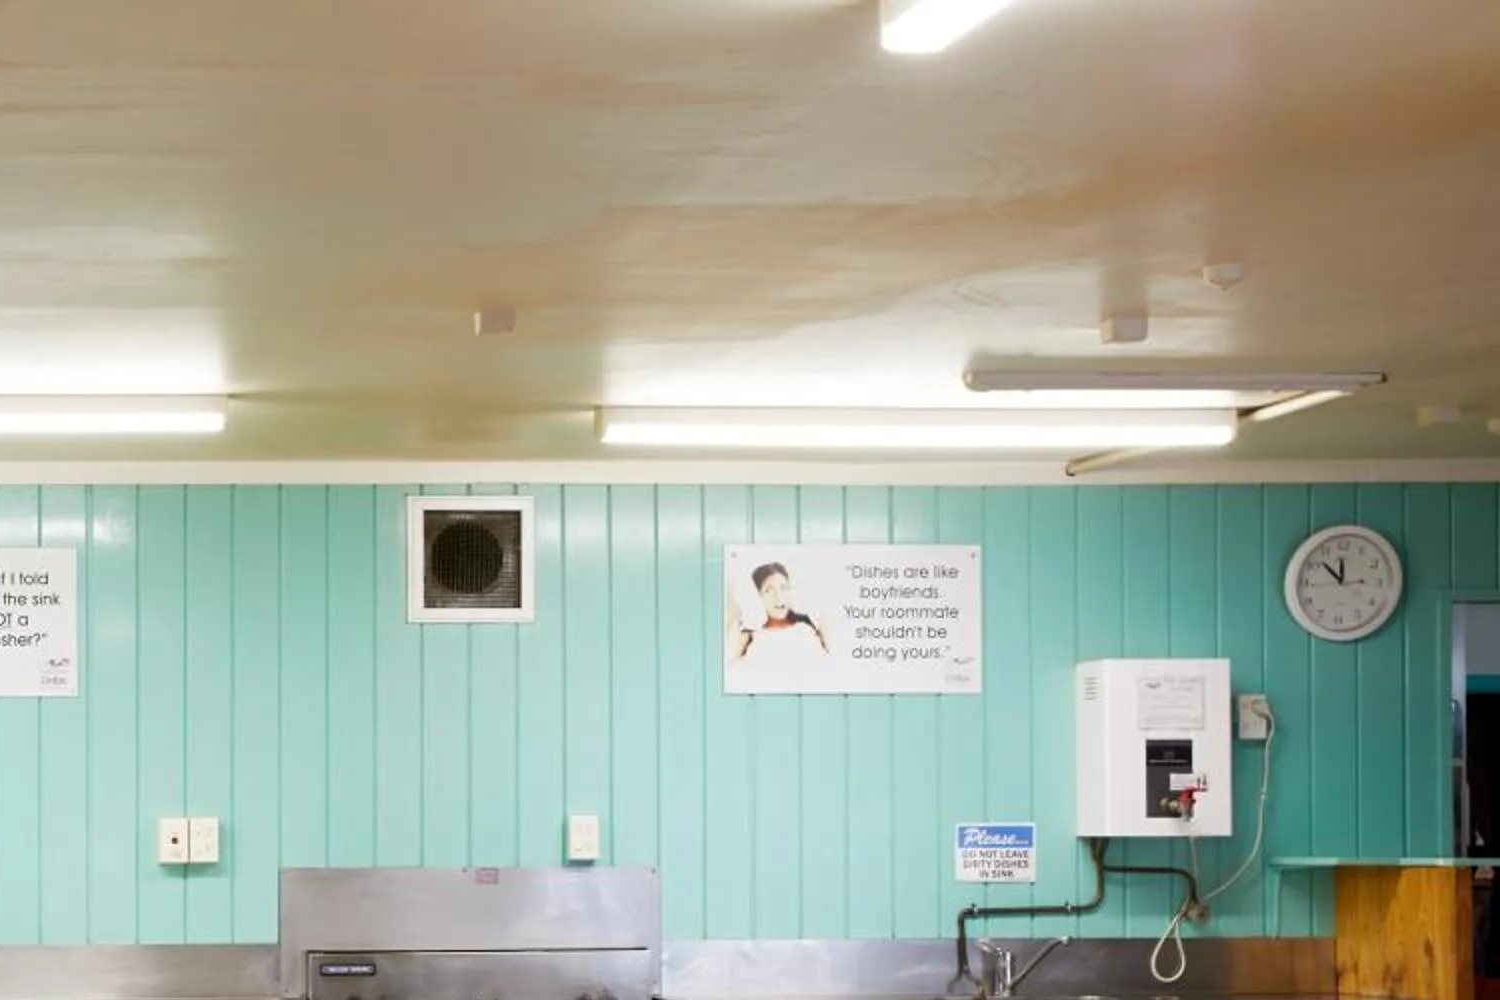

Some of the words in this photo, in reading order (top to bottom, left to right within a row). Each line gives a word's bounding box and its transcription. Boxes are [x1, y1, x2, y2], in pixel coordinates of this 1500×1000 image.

[19, 571, 49, 585] told
[846, 565, 899, 579] "Dishes
[903, 569, 930, 579] are
[934, 565, 960, 579] like
[2, 591, 27, 606] the
[31, 591, 60, 606] sink
[860, 585, 944, 601] boyfriends.
[844, 605, 876, 619] Your
[881, 605, 960, 619] roommate
[18, 616, 29, 626] a
[855, 625, 923, 639] shouldn't
[927, 625, 948, 639] be
[852, 645, 897, 661] doing
[902, 645, 951, 660] yours."
[979, 850, 997, 859] NOT
[991, 870, 1014, 878] SINK
